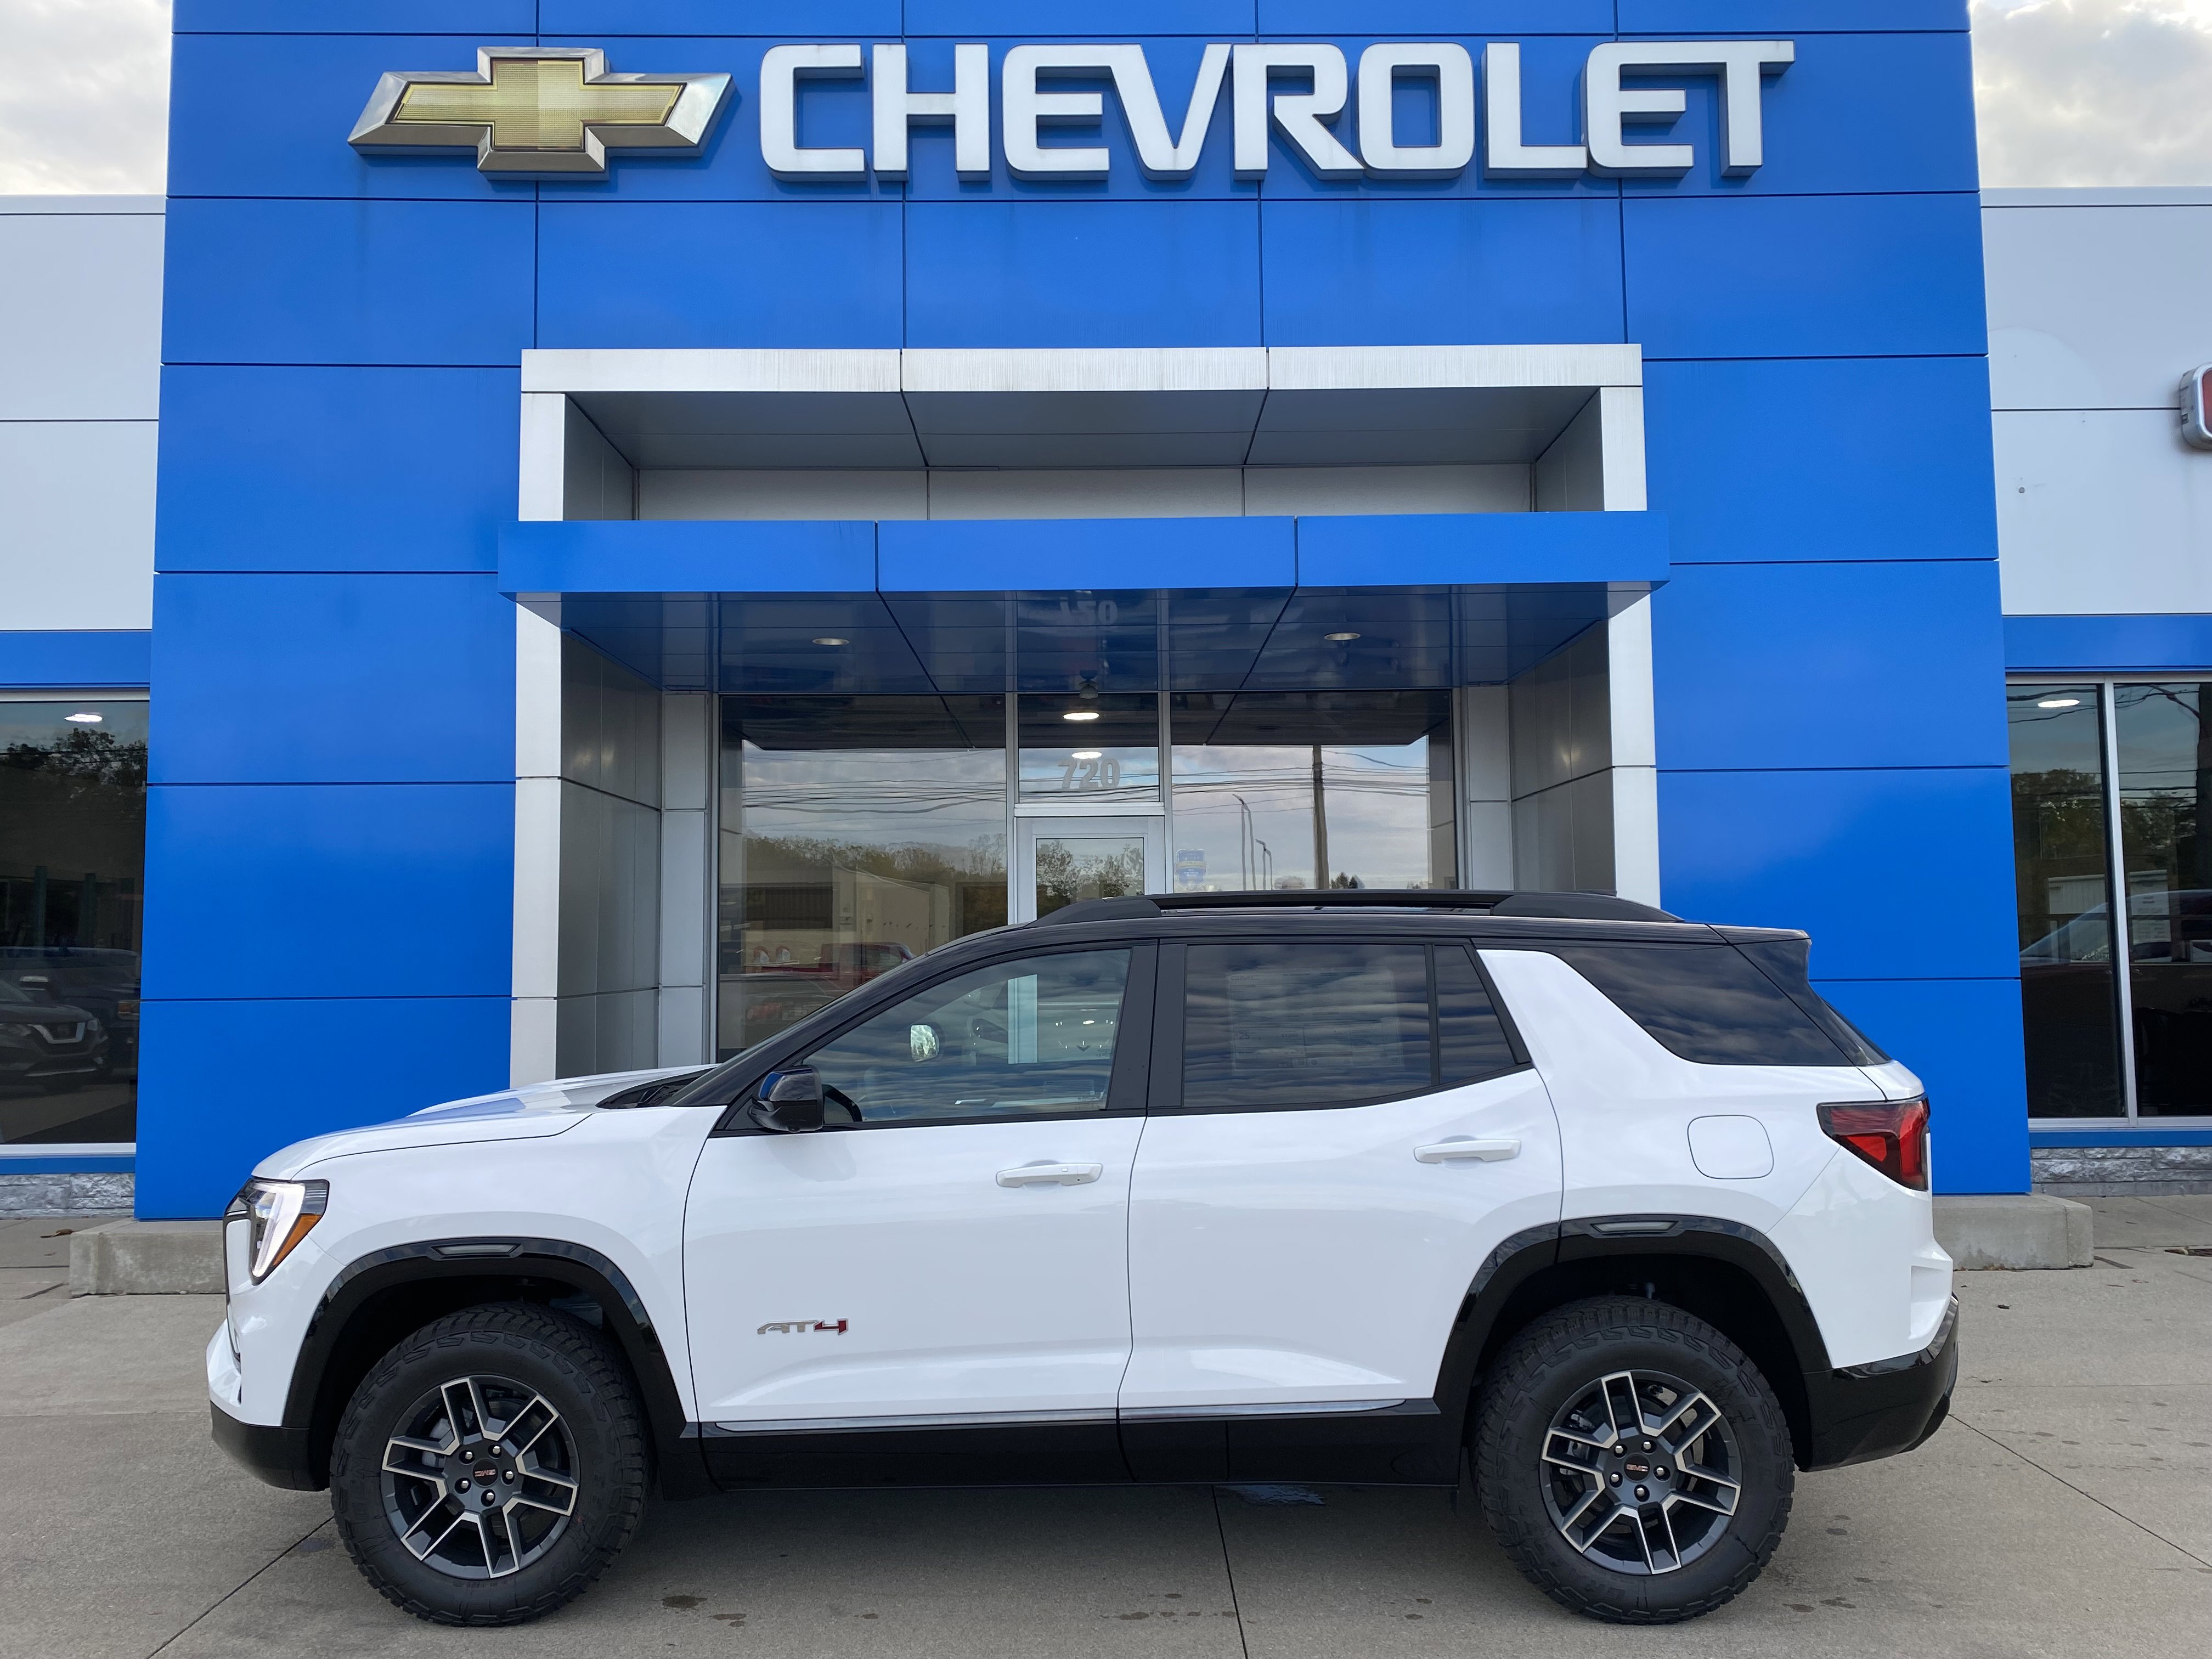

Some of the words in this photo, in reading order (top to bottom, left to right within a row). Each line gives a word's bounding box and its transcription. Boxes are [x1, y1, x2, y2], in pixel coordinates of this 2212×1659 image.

[760, 40, 1795, 178] CHEVROLET
[1058, 759, 1120, 788] 720
[1239, 1031, 1250, 1040] 25
[757, 1318, 848, 1335] AT4
